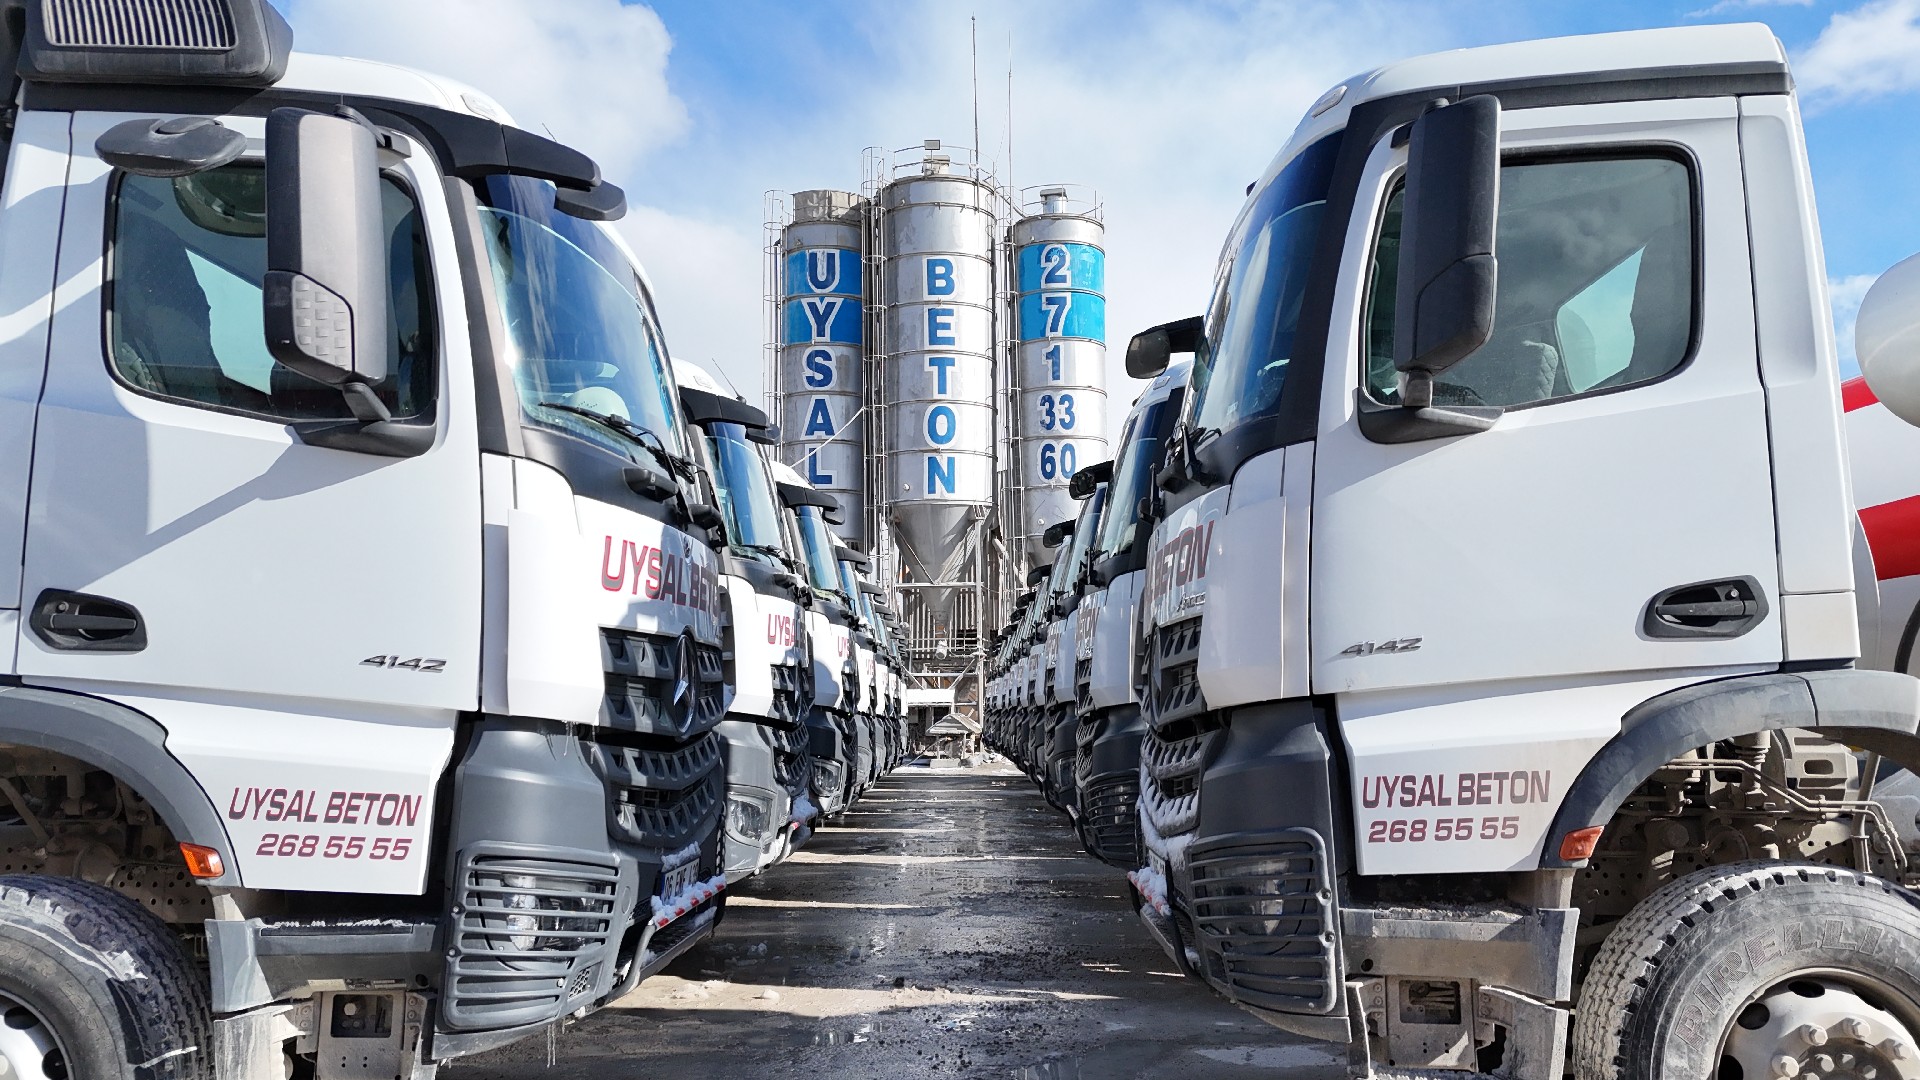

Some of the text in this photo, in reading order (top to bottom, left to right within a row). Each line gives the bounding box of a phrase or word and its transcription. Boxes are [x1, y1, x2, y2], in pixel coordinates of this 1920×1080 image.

[802, 250, 840, 486] UYSAL
[925, 257, 957, 496] BETON
[601, 535, 721, 620] UYSAL BETO
[1153, 520, 1214, 599] BETON
[358, 654, 447, 673] 4142
[1340, 636, 1424, 657] 4142
[229, 787, 422, 827] UYSAL BETON
[1362, 770, 1550, 808] UYSAL BETON
[256, 833, 413, 861] 268 55 55
[1368, 816, 1520, 844] 268 55 55
[1674, 919, 1885, 1052] PIRELLI
